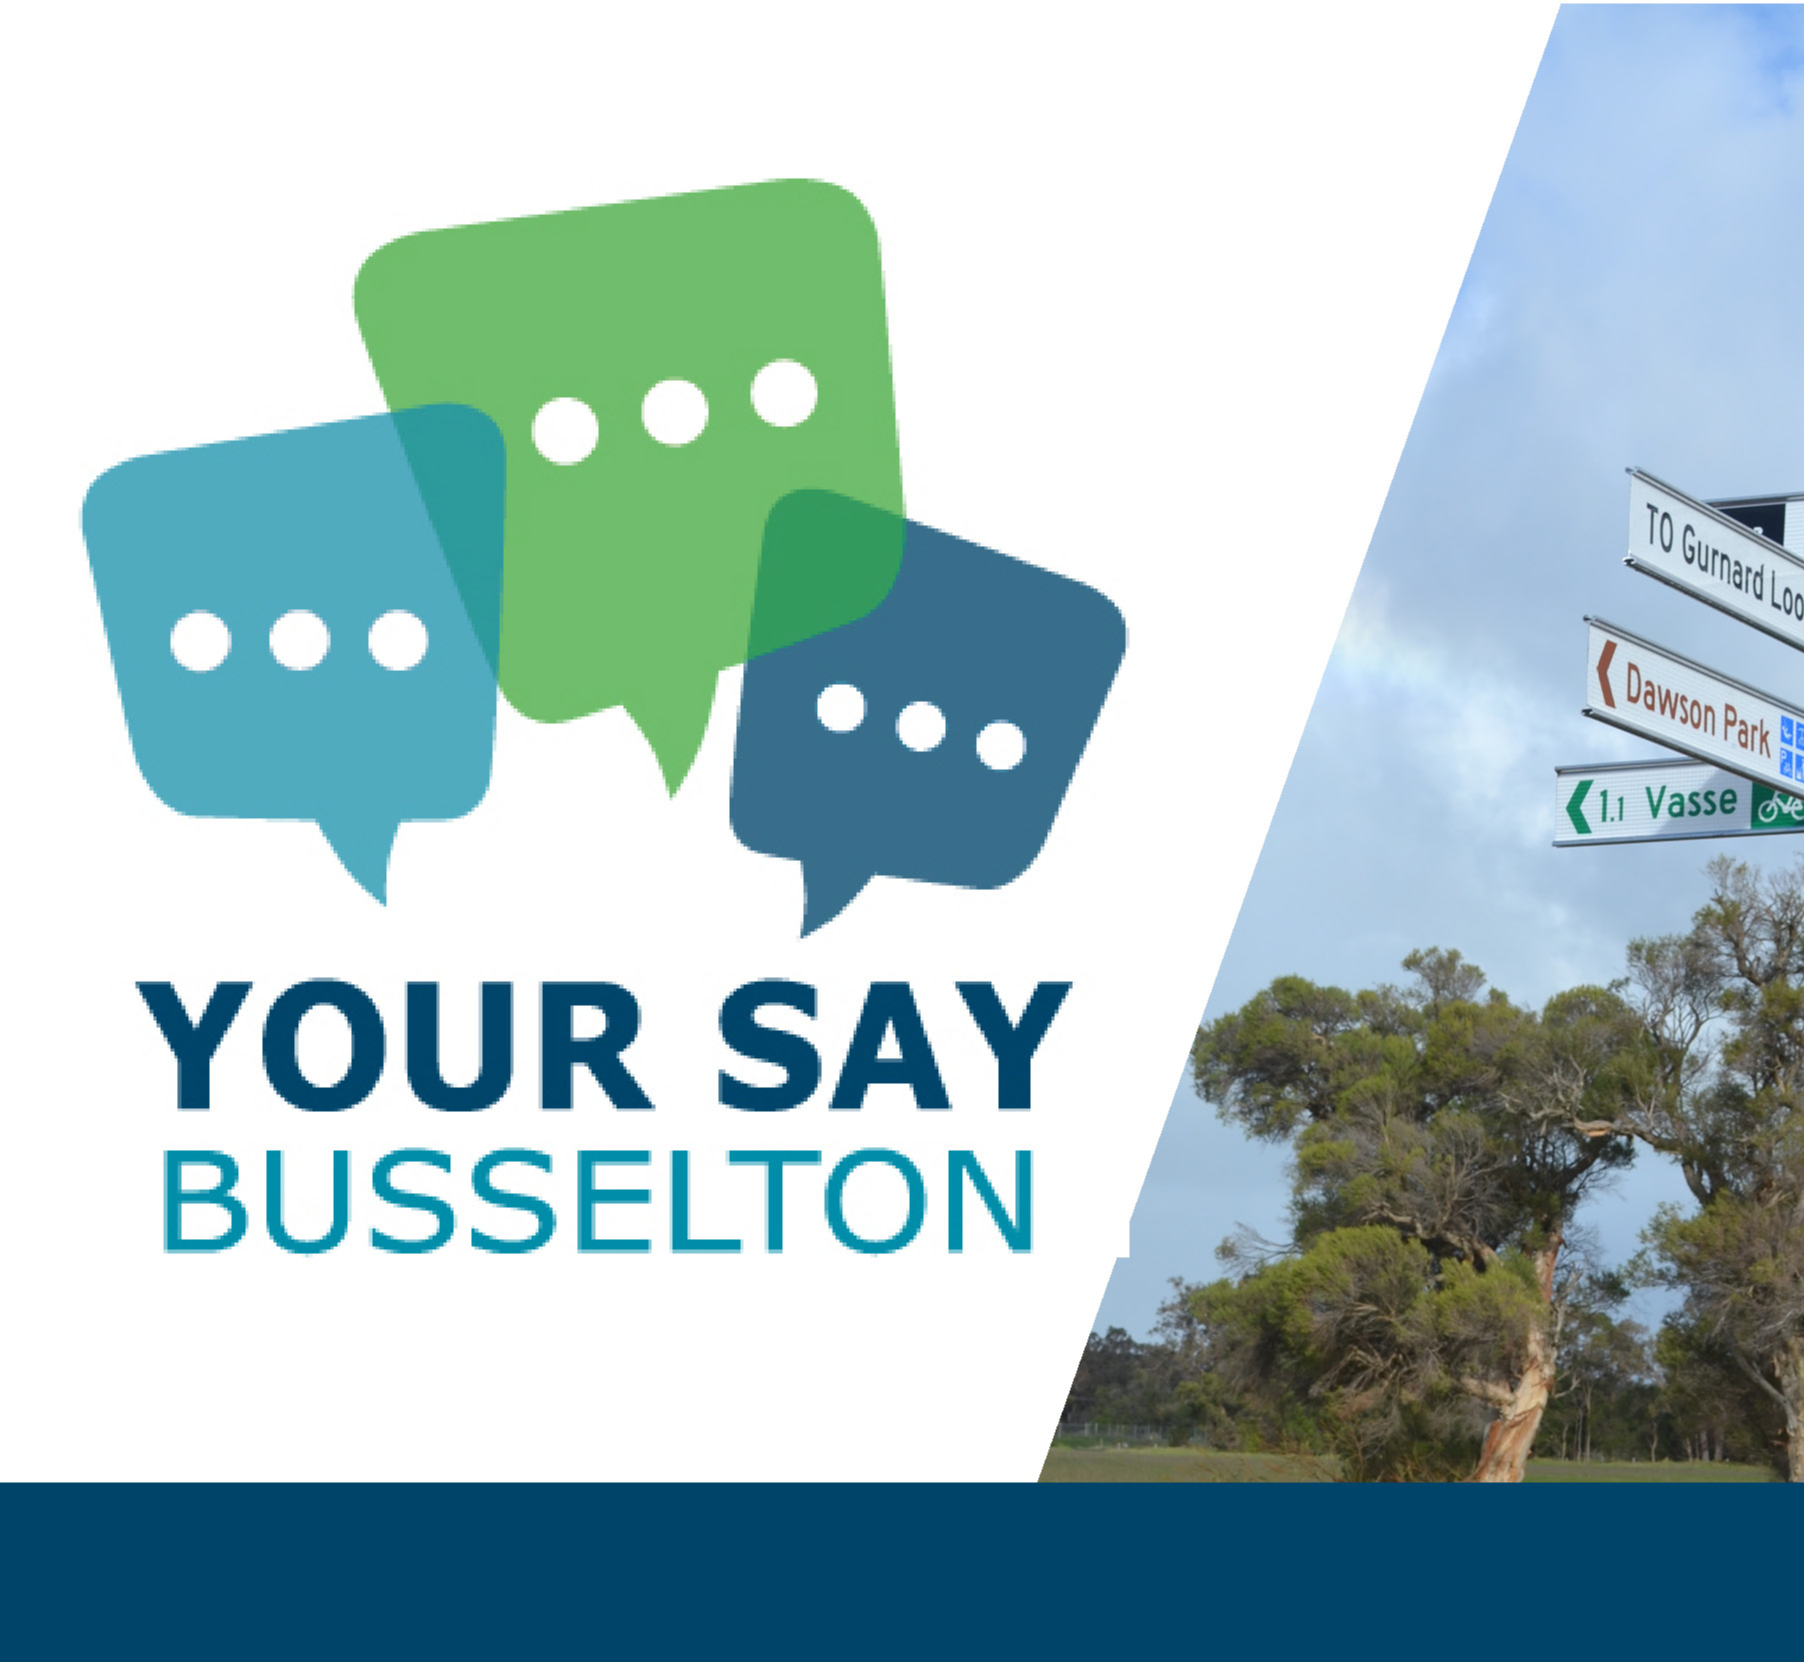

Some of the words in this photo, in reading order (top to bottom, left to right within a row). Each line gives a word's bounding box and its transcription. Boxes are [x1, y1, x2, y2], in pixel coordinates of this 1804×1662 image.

[1646, 502, 1674, 554] TO
[1682, 523, 1765, 602] Gurnard
[1626, 662, 1716, 737] Dawson
[1724, 703, 1772, 759] Park
[1600, 789, 1624, 823] 1.1
[1645, 784, 1738, 819] Vasse
